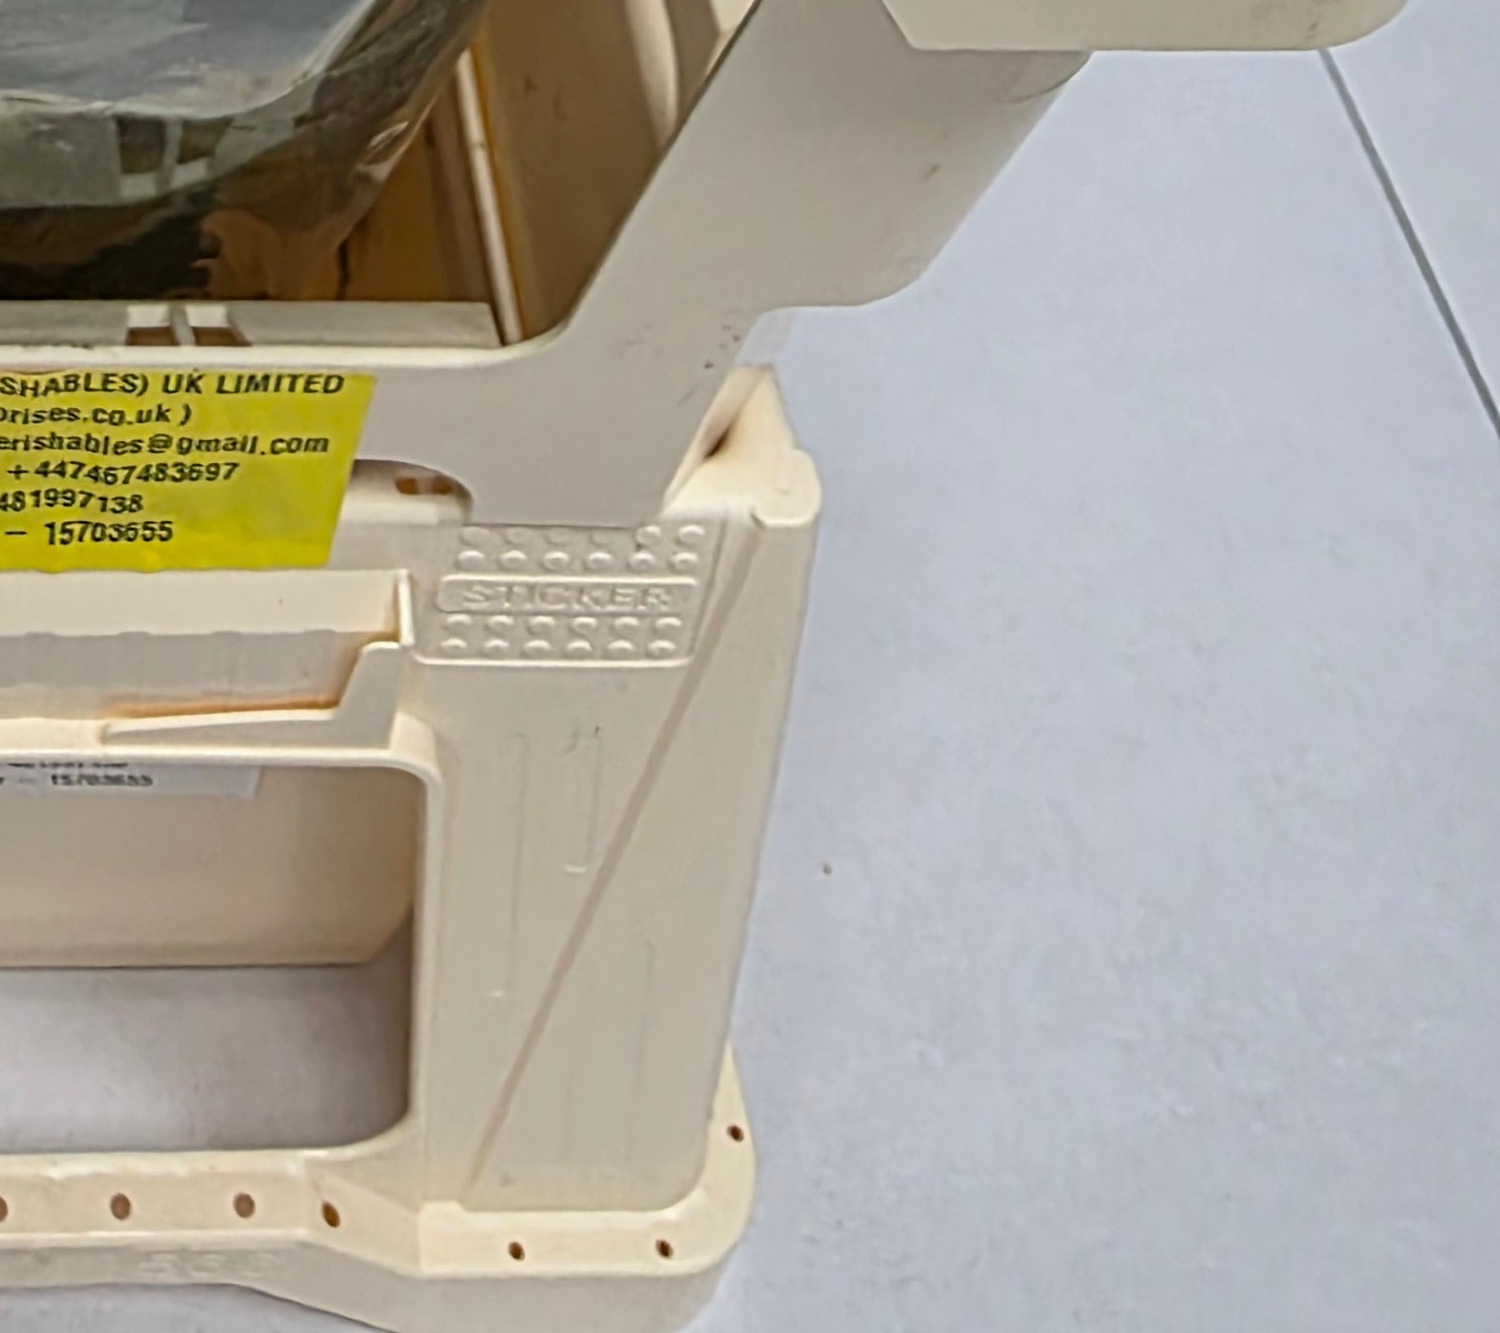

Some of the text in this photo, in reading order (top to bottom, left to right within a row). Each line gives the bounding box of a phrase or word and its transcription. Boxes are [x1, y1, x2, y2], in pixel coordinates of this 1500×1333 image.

[162, 373, 202, 394] UK
[216, 374, 345, 394] LIMITED
[7, 461, 240, 485] +447467483697
[44, 521, 173, 546] 15703655
